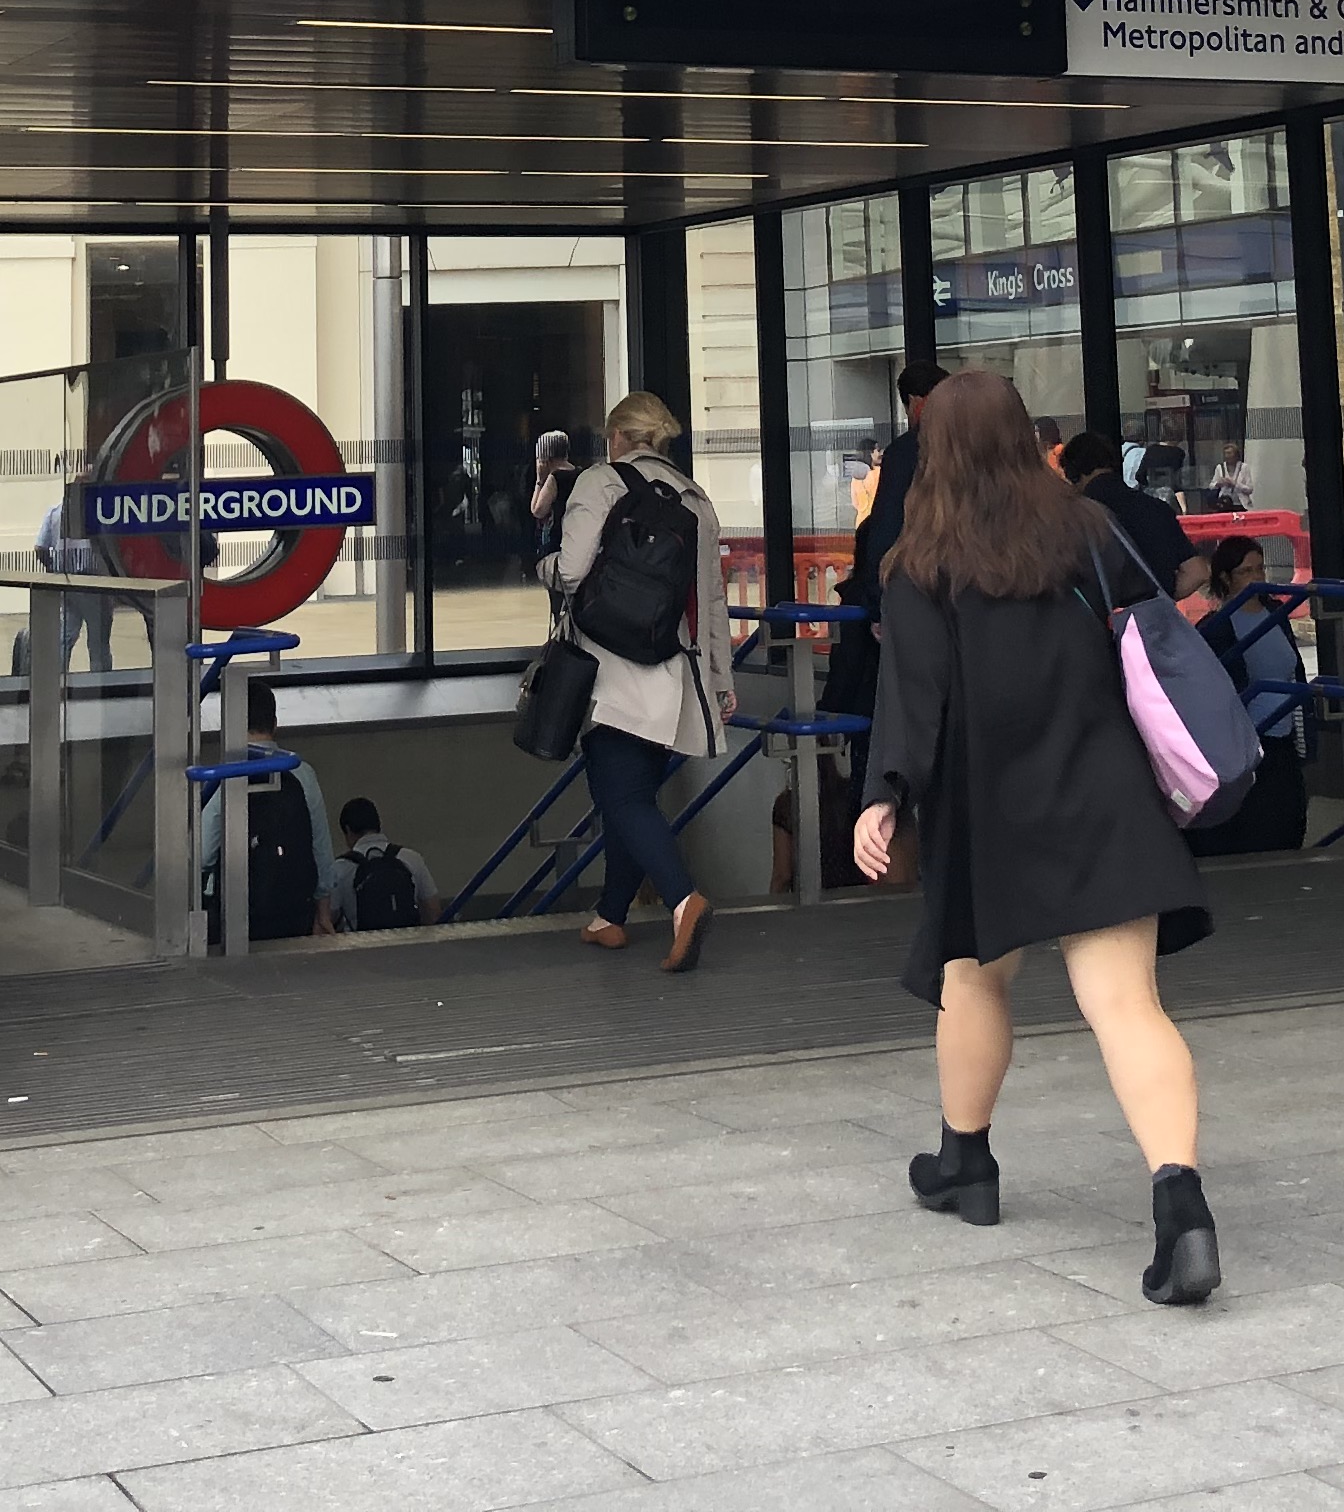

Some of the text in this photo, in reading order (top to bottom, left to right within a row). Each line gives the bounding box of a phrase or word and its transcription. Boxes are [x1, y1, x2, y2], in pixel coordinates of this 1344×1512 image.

[1102, 21, 1285, 58] Metropolitan
[1294, 30, 1343, 56] and
[987, 263, 1075, 300] King's Cross
[96, 485, 363, 526] UNDERGROUND
